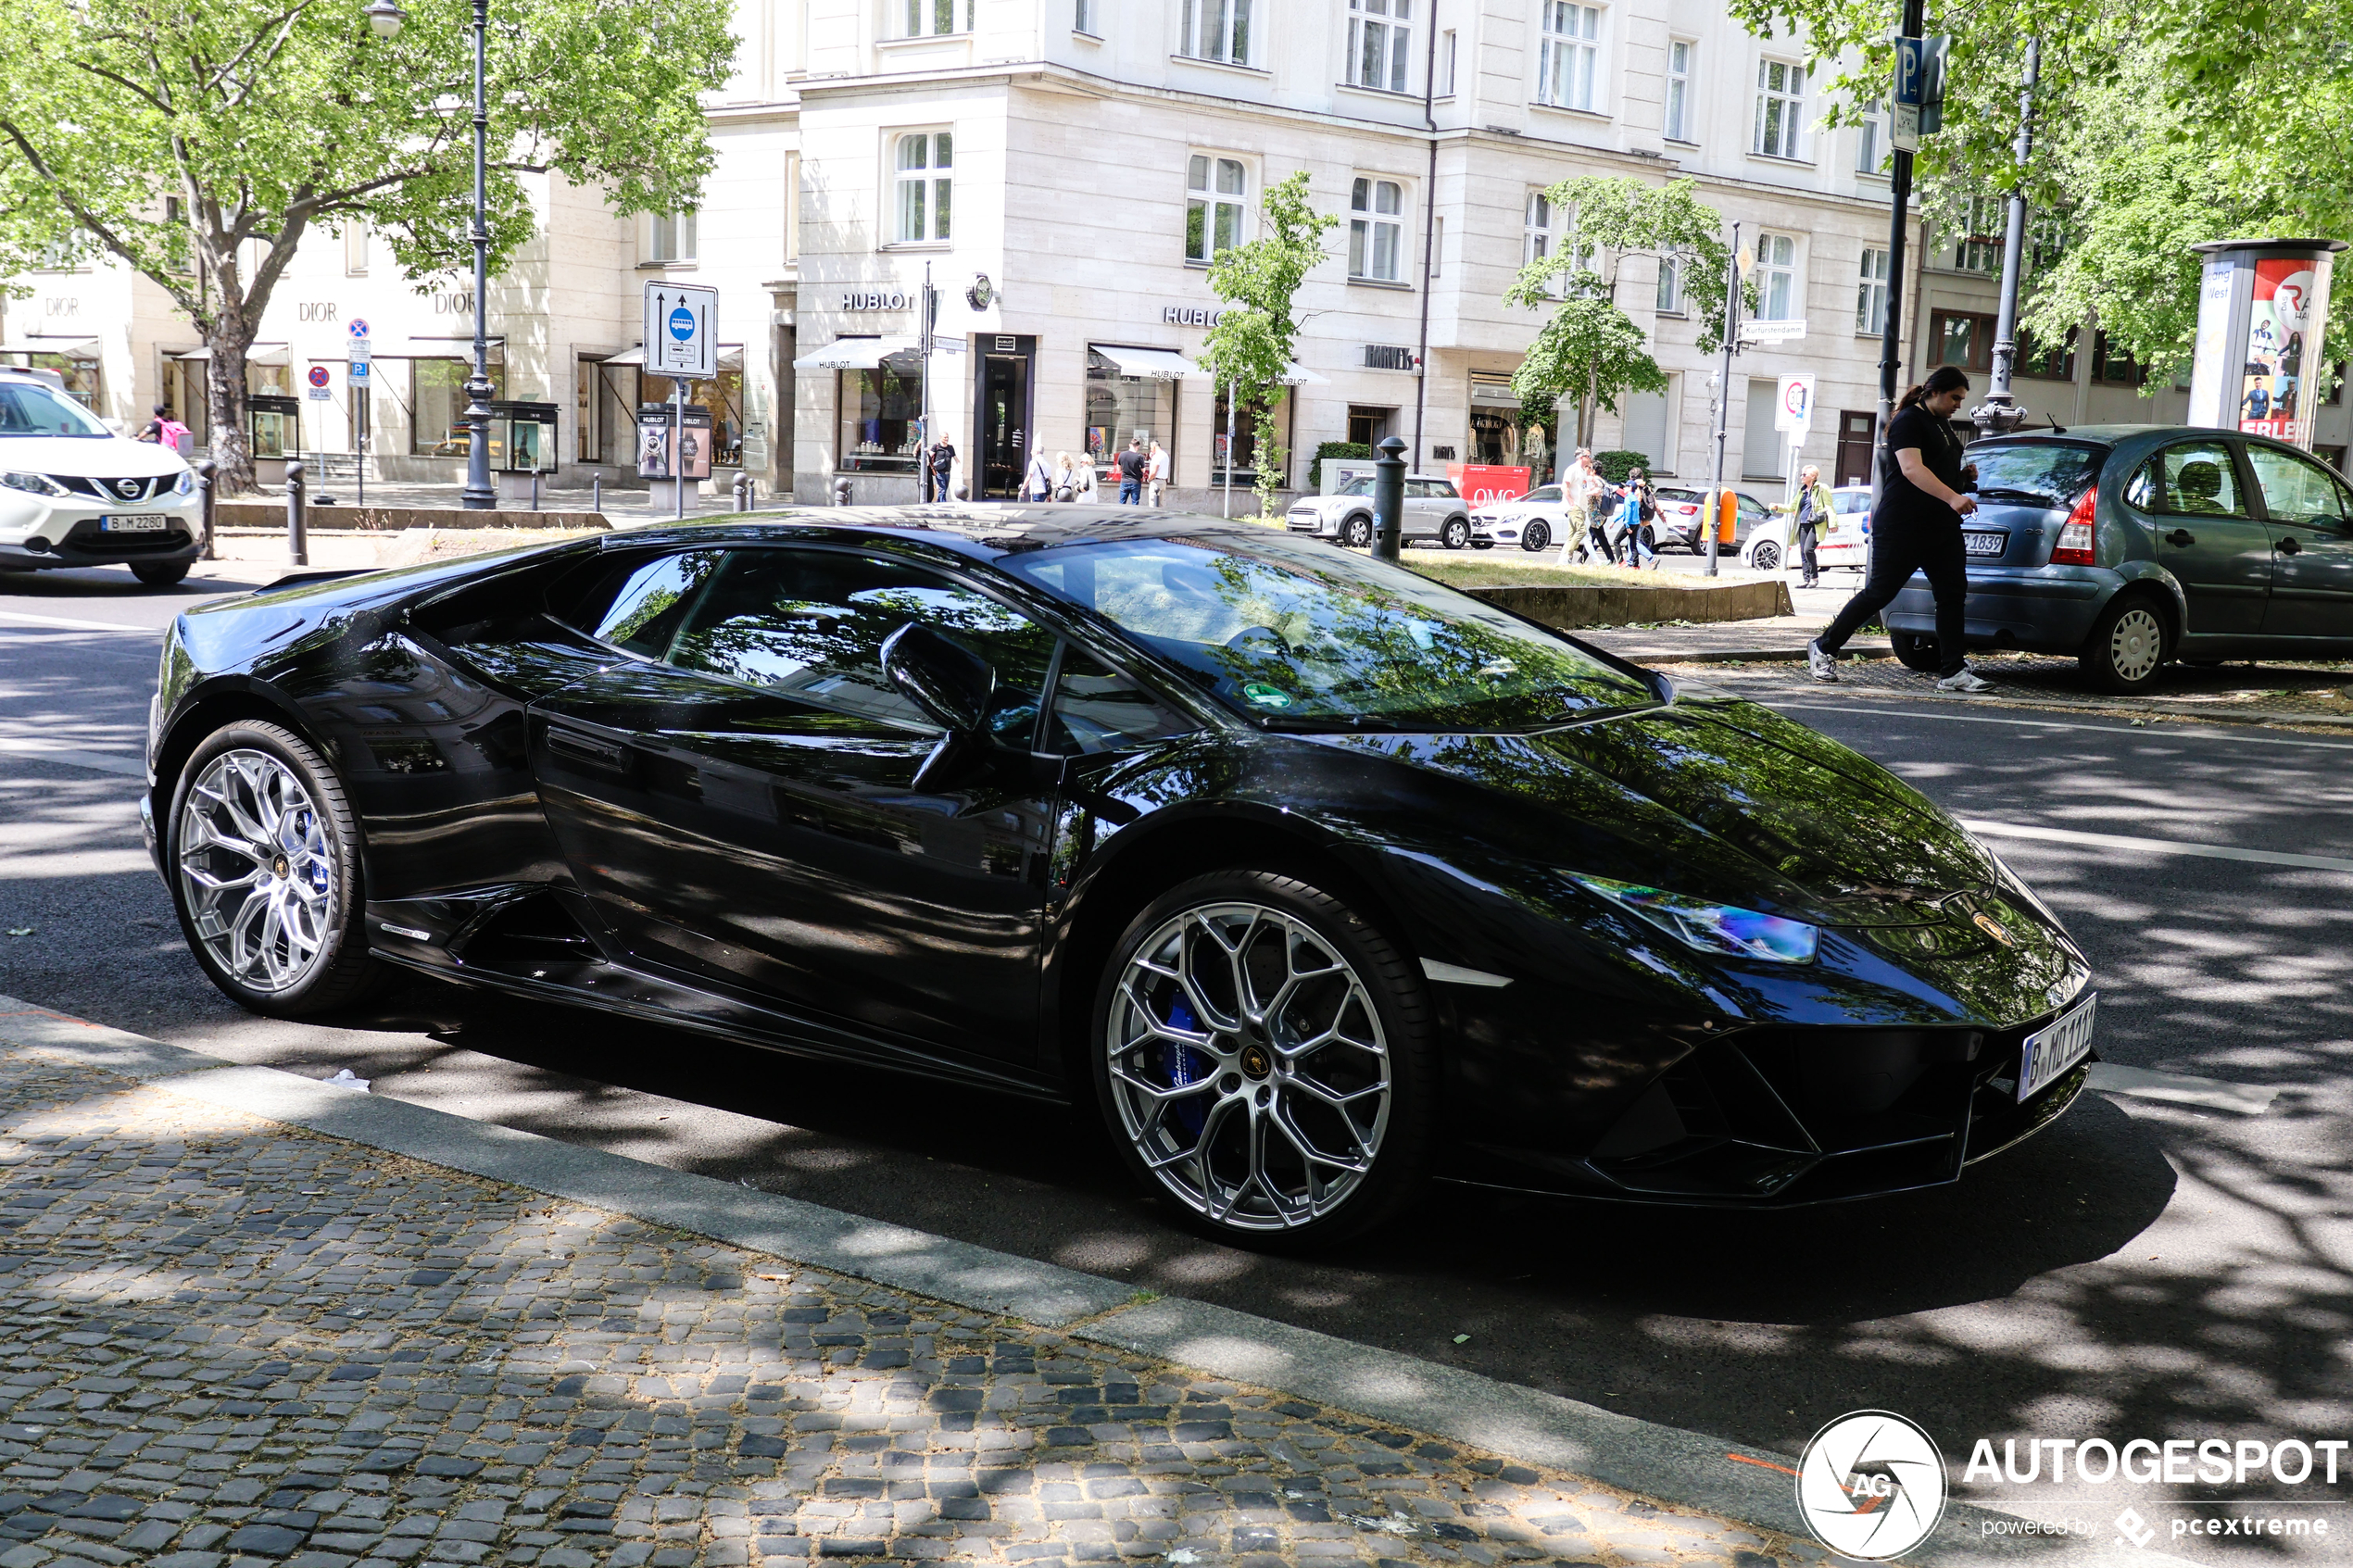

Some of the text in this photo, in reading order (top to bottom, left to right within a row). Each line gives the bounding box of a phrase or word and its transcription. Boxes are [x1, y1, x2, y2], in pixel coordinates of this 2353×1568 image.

[2207, 270, 2230, 283] gang
[841, 293, 914, 310] HUBLOT
[2207, 287, 2228, 299] West
[46, 297, 81, 317] DIOR
[299, 302, 338, 321] DIOR
[435, 293, 475, 314] DIOR
[1164, 307, 1227, 327] HUBLO
[1745, 326, 1802, 334] Kurfürstendamm
[1151, 370, 1185, 380] HUBLOT
[112, 518, 120, 529] B
[1970, 534, 2002, 551] 1839
[2029, 1003, 2095, 1088] B MD 1111
